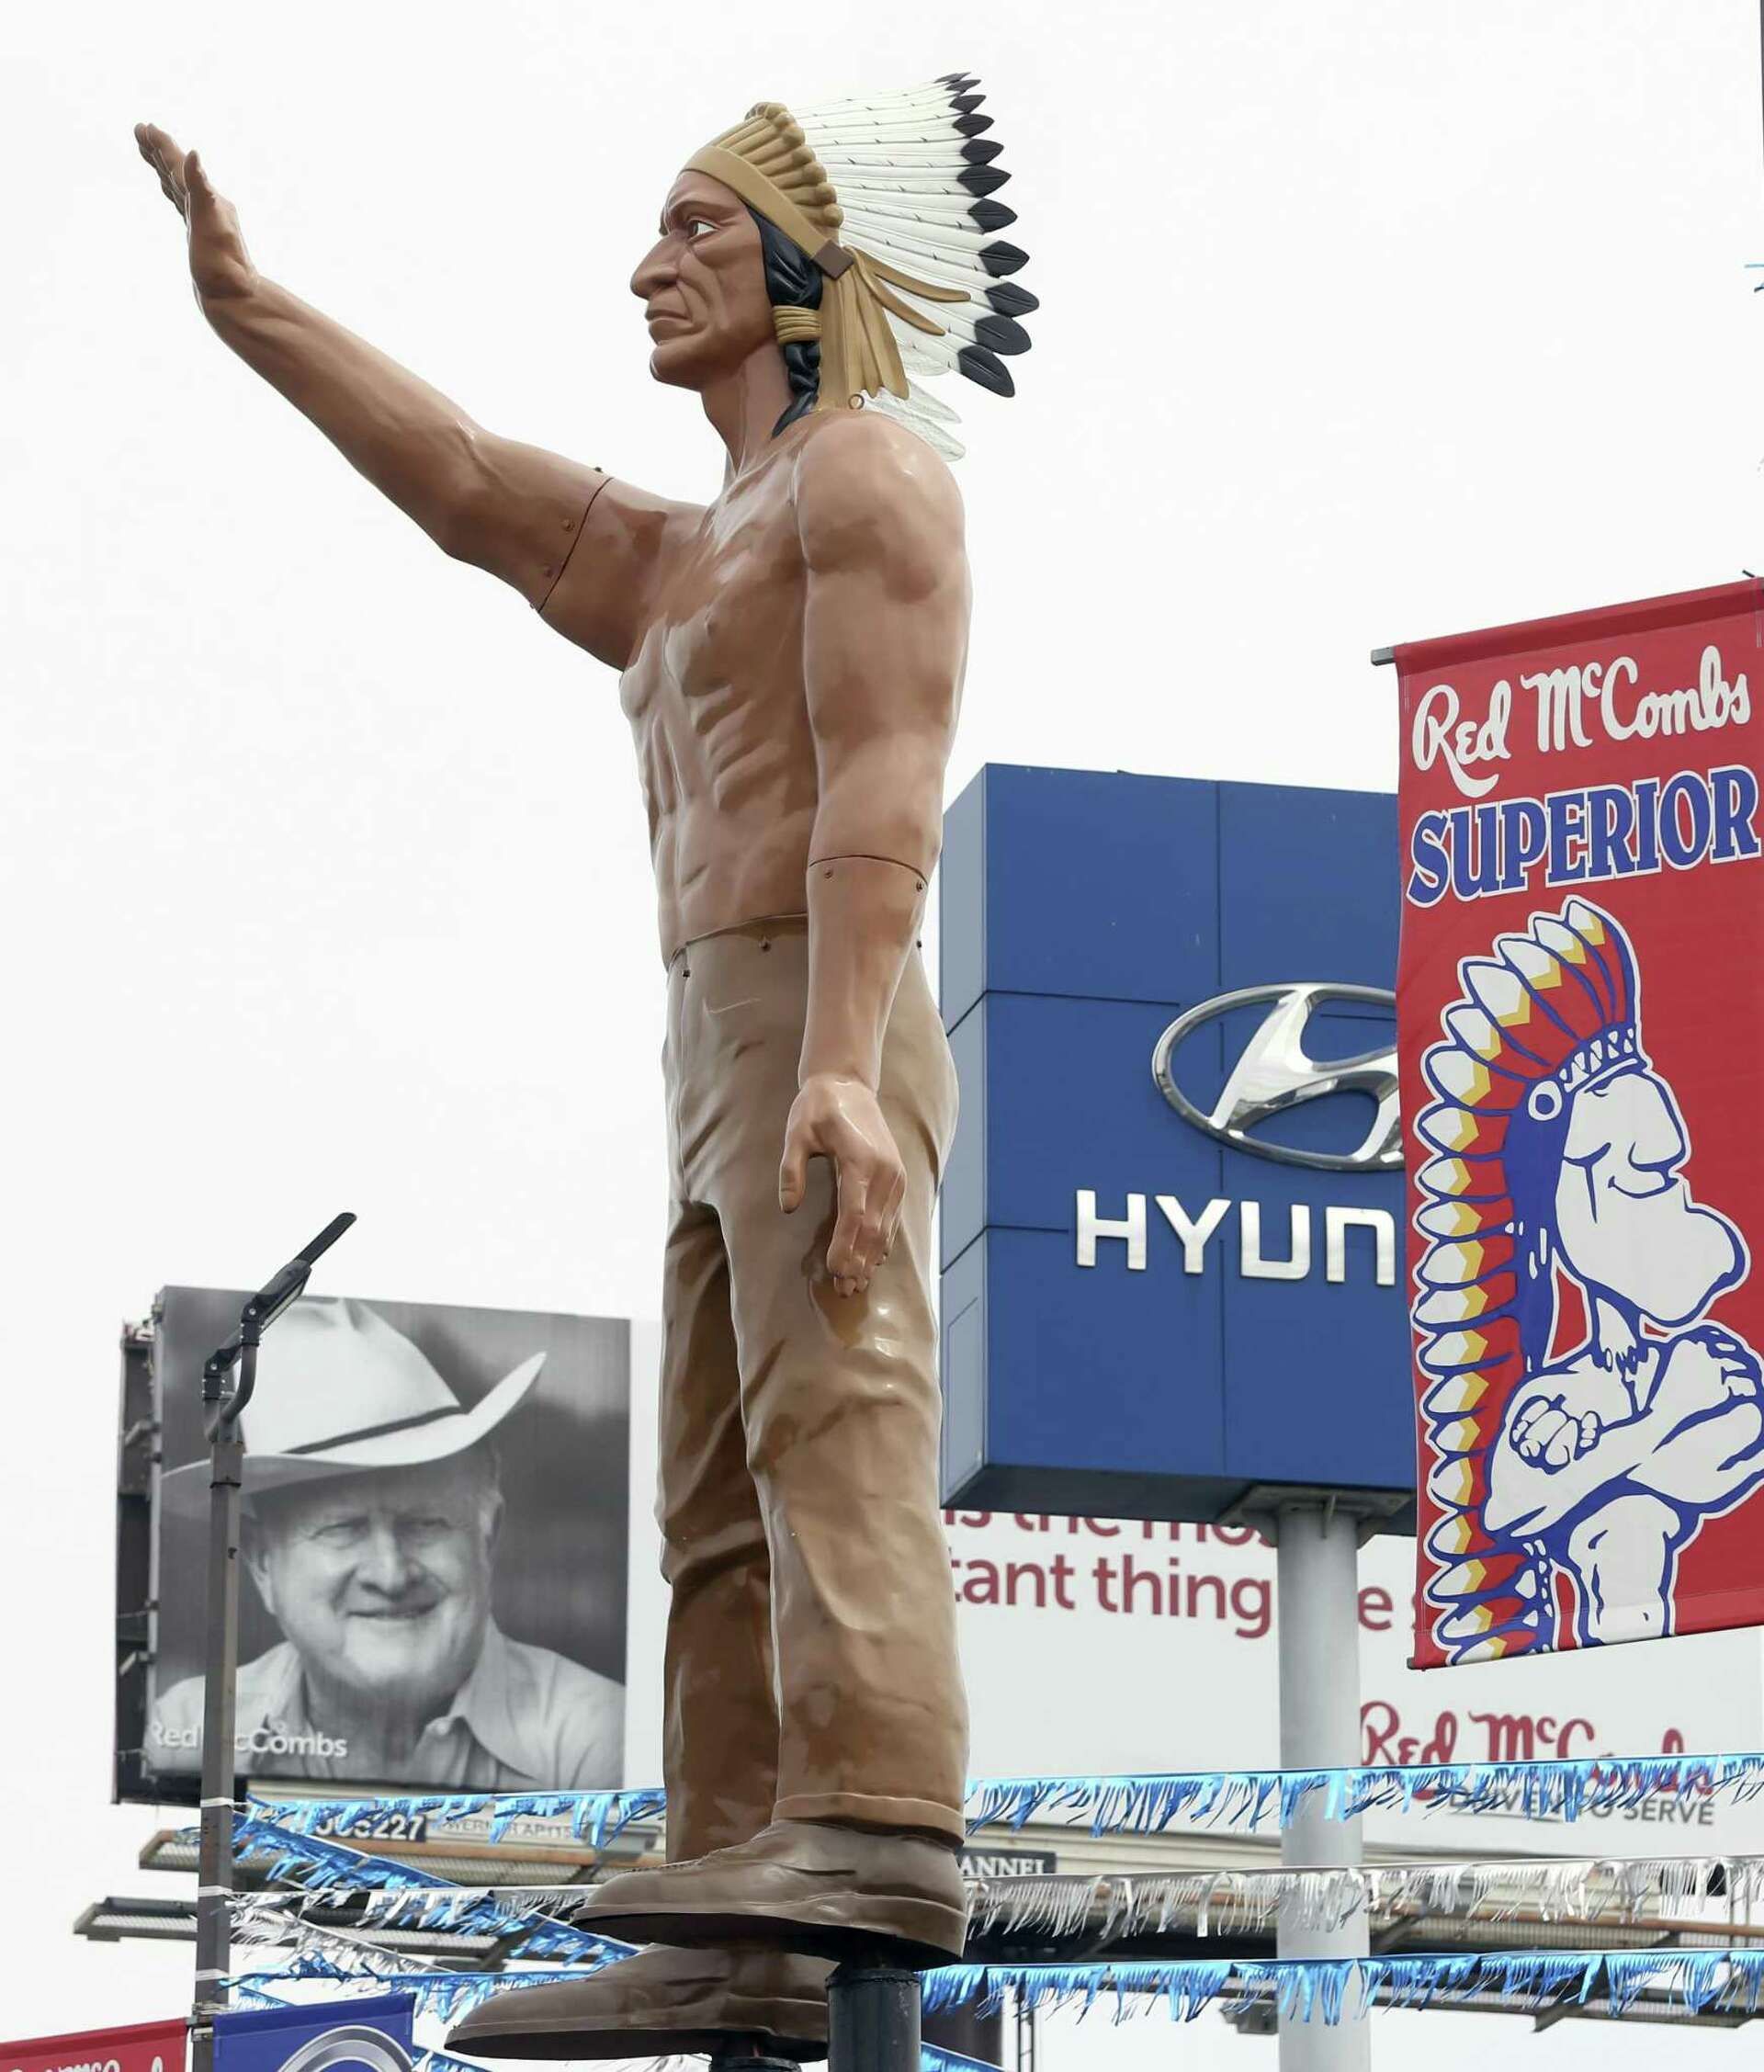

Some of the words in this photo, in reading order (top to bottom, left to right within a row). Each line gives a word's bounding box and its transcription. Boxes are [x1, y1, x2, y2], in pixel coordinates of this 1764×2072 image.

[1412, 680, 1512, 798] Red
[1521, 645, 1751, 753] McCombs
[1406, 764, 1762, 908] SUPERIOR
[1092, 1553, 1272, 1639] thing
[1623, 1796, 1715, 1826] SERVE
